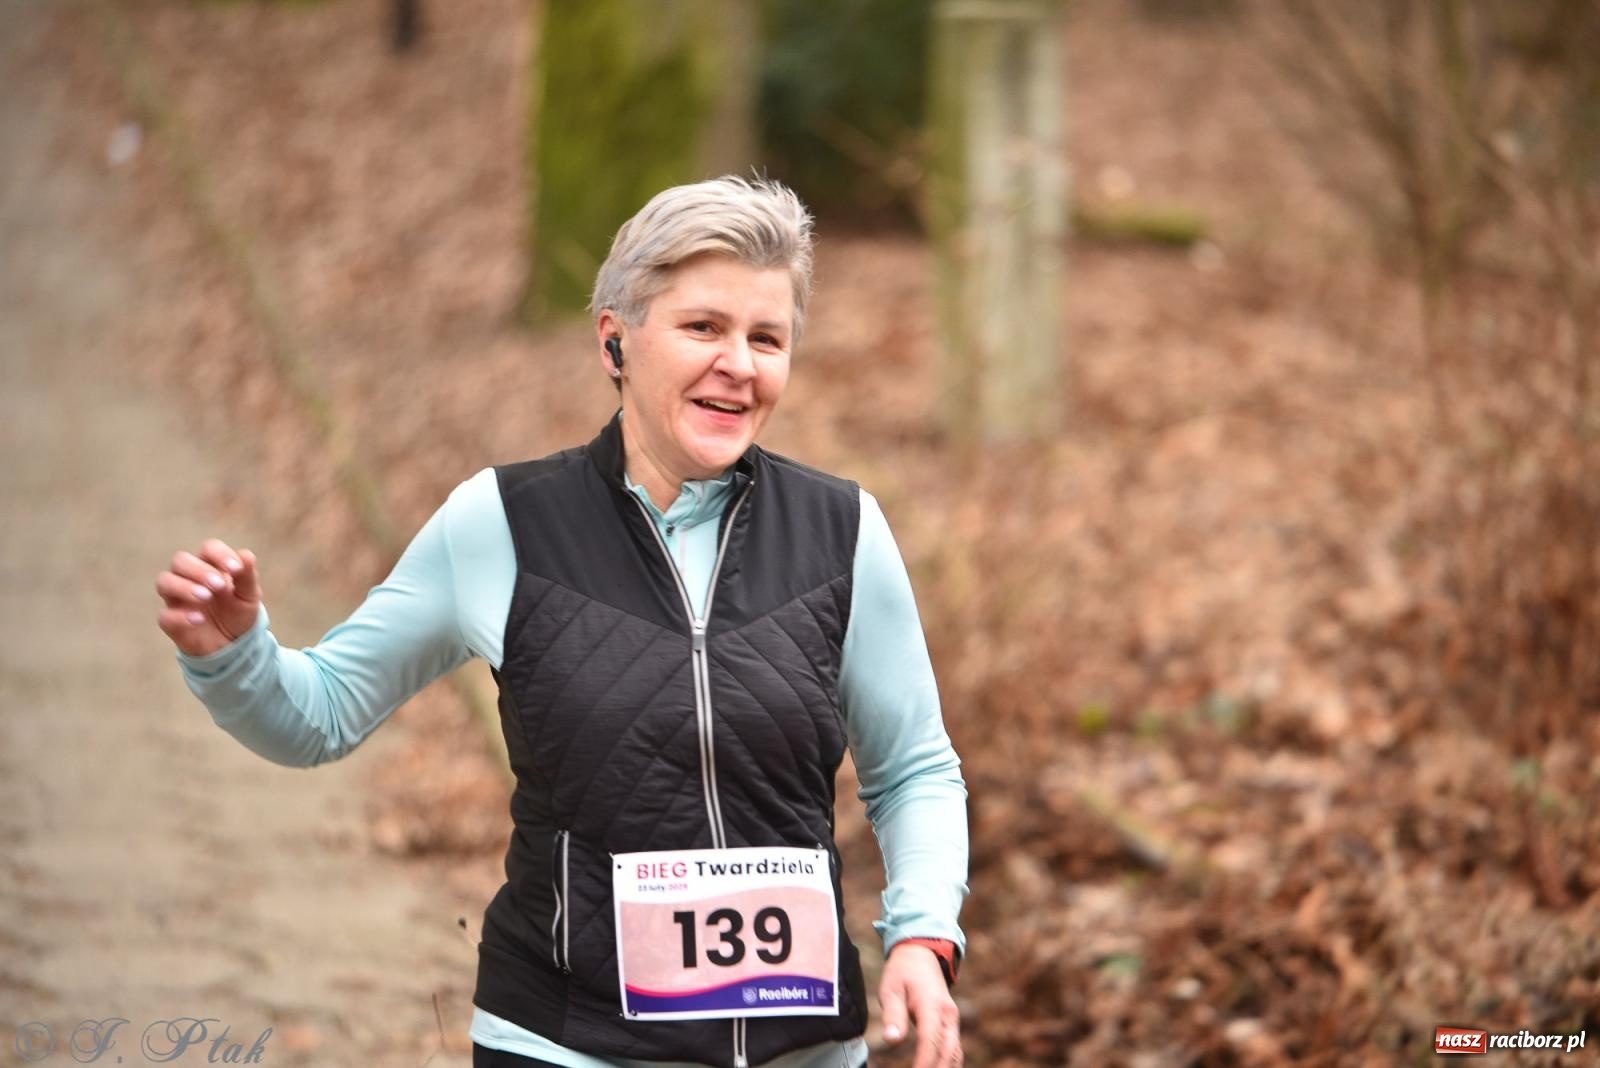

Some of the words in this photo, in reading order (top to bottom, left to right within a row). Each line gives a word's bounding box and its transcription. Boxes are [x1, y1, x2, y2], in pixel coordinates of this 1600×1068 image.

[637, 862, 688, 879] BIEG
[695, 857, 814, 877] Twardziela
[673, 906, 792, 968] 139
